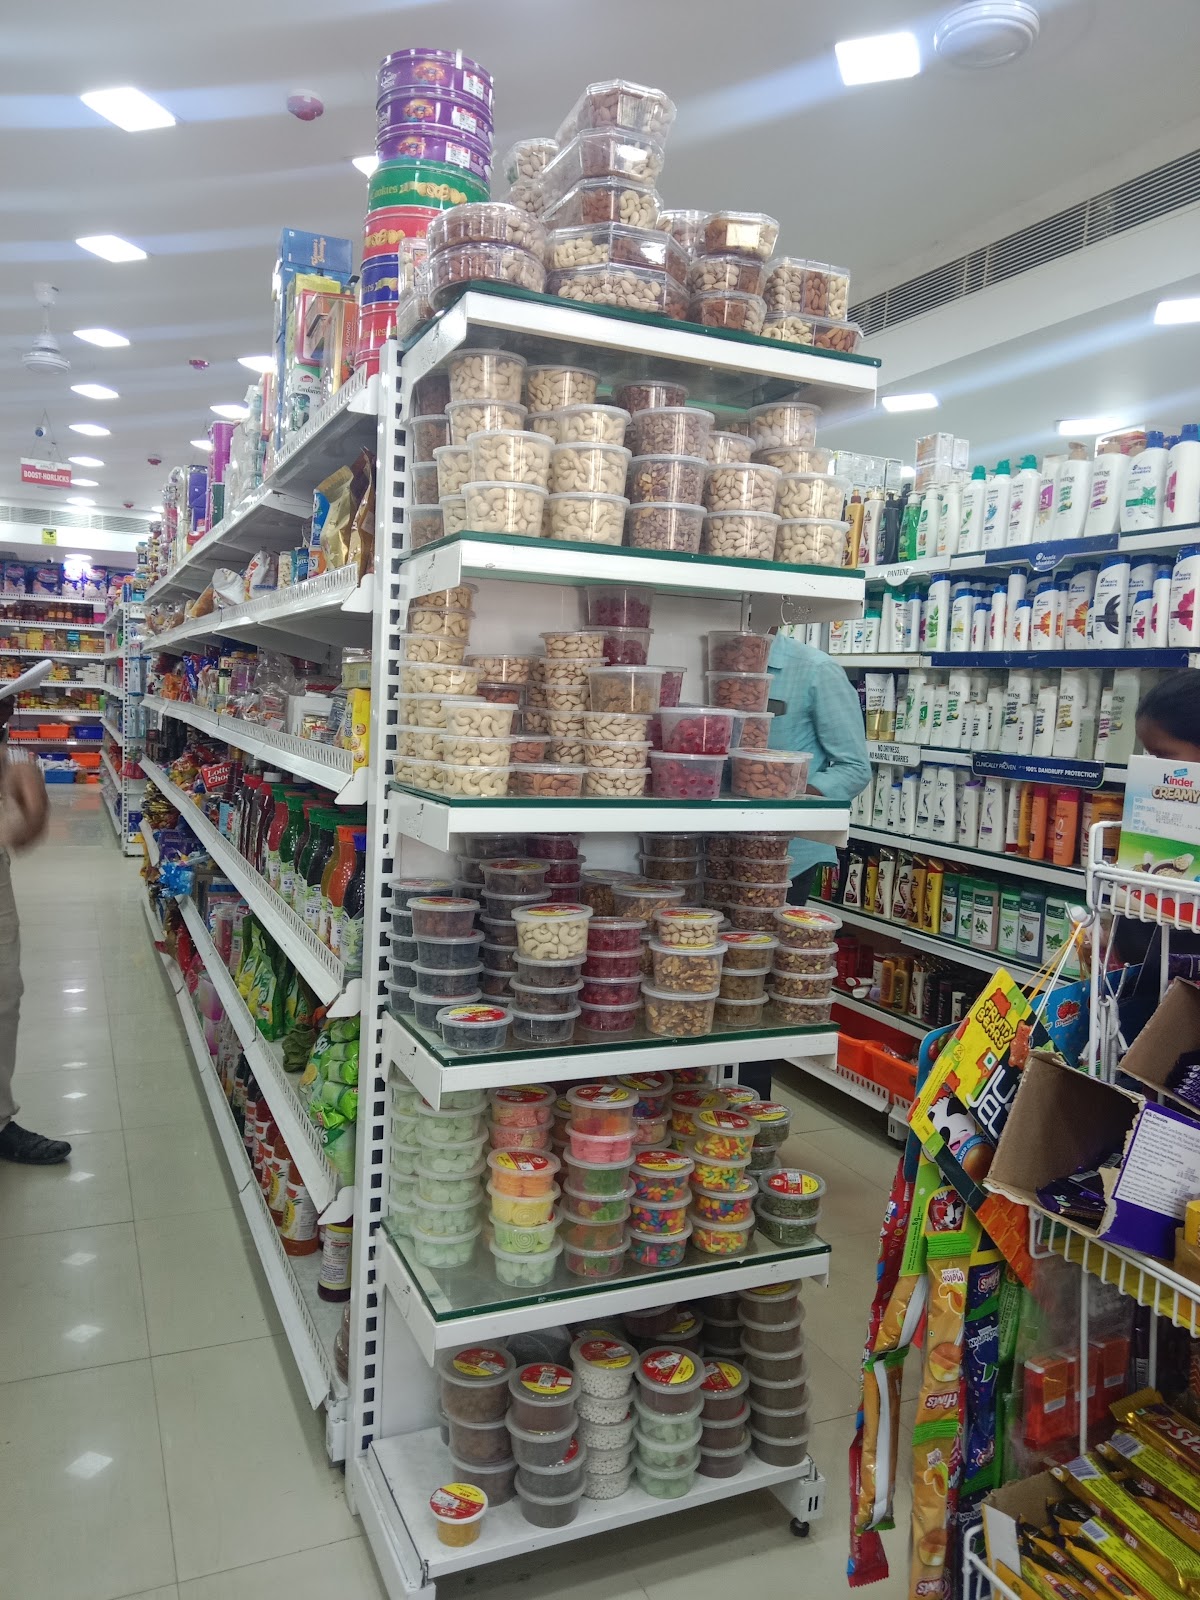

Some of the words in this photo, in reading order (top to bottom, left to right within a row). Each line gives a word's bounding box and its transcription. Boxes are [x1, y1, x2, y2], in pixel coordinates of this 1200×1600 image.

[23, 470, 70, 483] BOOST-HORLICKS
[886, 568, 910, 578] PANTENE
[975, 761, 999, 769] CLINICALLY
[1038, 767, 1065, 776] DANDRUFF
[1152, 786, 1200, 804] CREAMY
[984, 999, 1016, 1043] FRUITY
[1051, 1550, 1066, 1565] NEW
[1095, 1562, 1111, 1576] NEW
[1044, 1573, 1059, 1586] NEW
